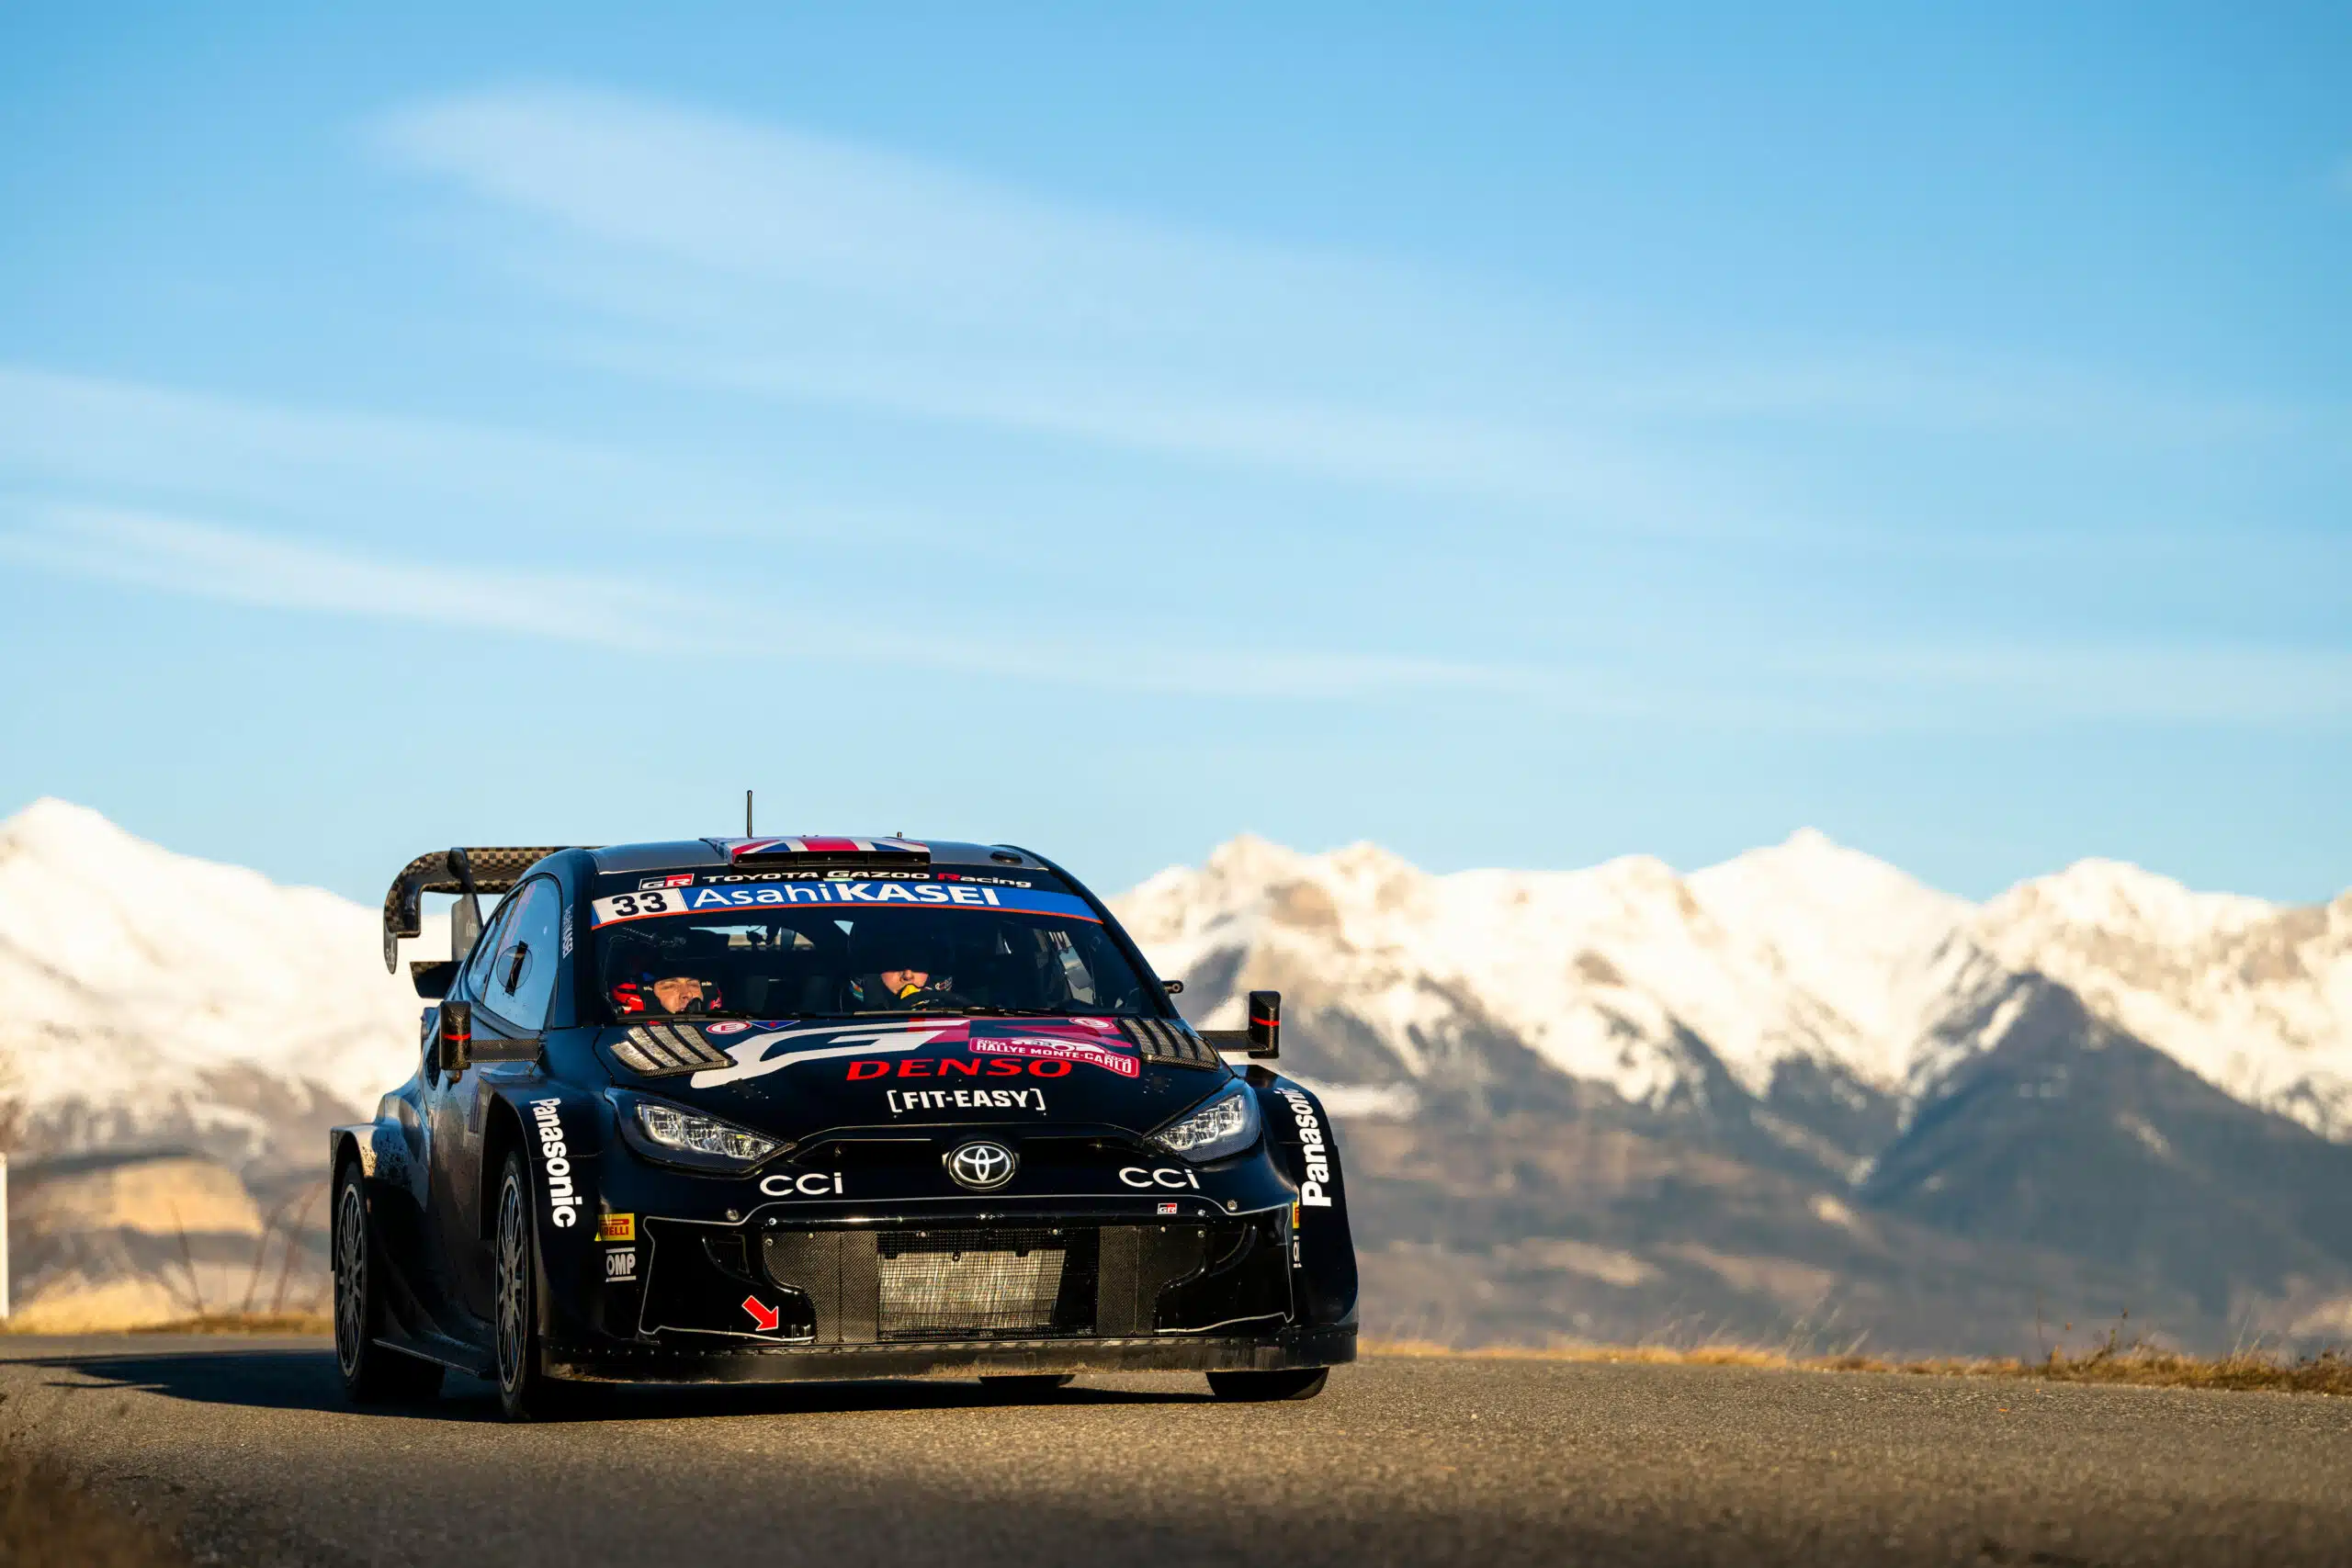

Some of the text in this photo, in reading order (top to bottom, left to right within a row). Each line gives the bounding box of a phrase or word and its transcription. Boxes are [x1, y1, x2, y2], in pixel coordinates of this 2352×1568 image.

[640, 870, 1032, 890] GR TOYOTA GAZOO Racing
[612, 892, 668, 917] 33
[977, 1041, 1132, 1074] RALLYE MONTE-CARLO
[846, 1058, 1072, 1081] DENSO
[529, 1098, 582, 1228] Panasonic
[1159, 1205, 1176, 1213] GR
[606, 1254, 636, 1276] OMP
